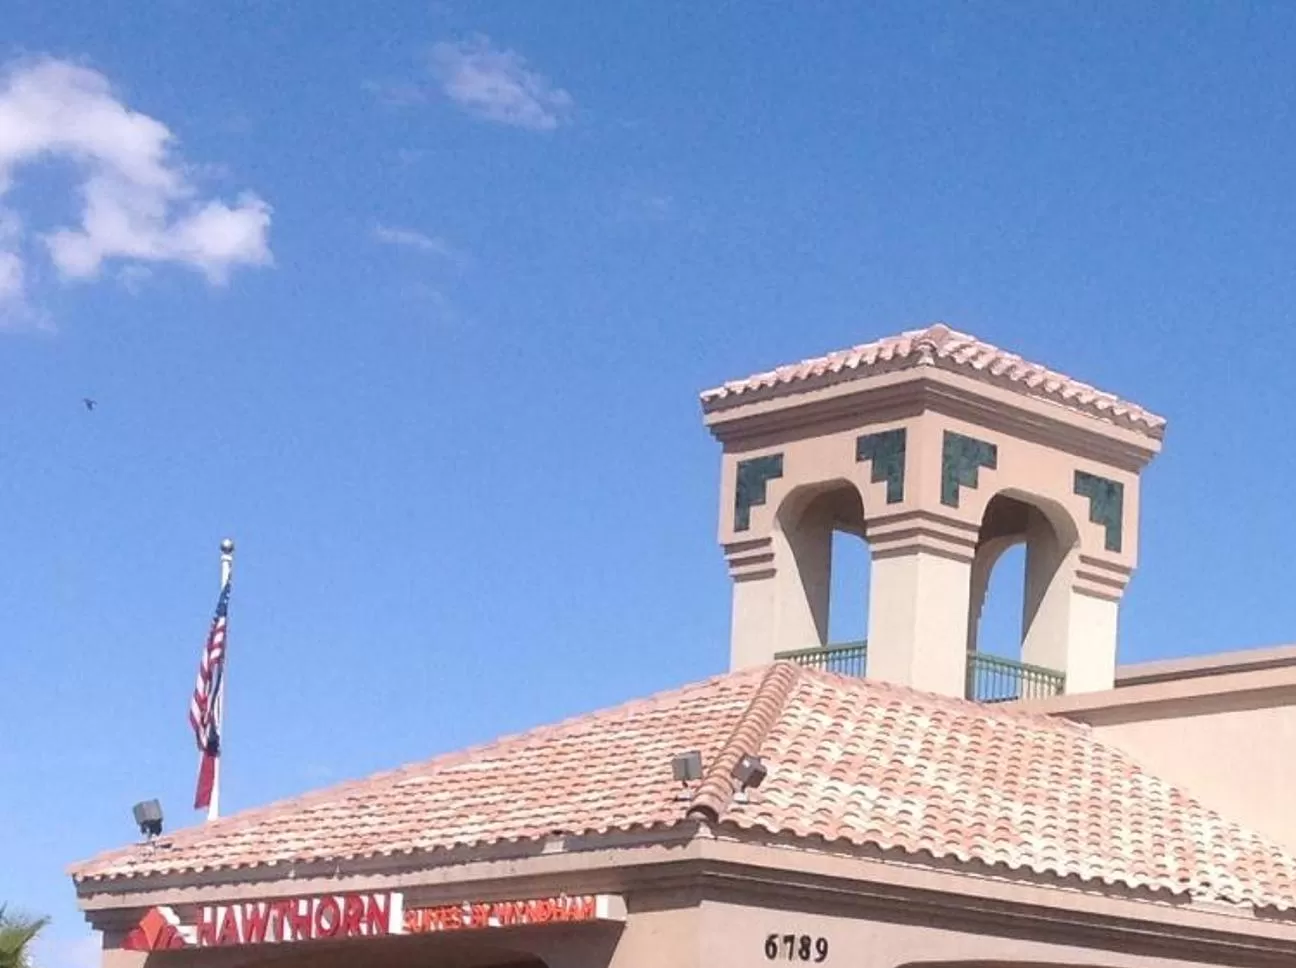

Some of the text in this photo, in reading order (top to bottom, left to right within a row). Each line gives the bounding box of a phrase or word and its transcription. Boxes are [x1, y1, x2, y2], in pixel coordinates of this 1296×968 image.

[196, 892, 392, 947] HAWTHORN
[403, 905, 462, 933] SUITES
[493, 894, 596, 925] WYNDHAM
[764, 934, 828, 963] 6789
